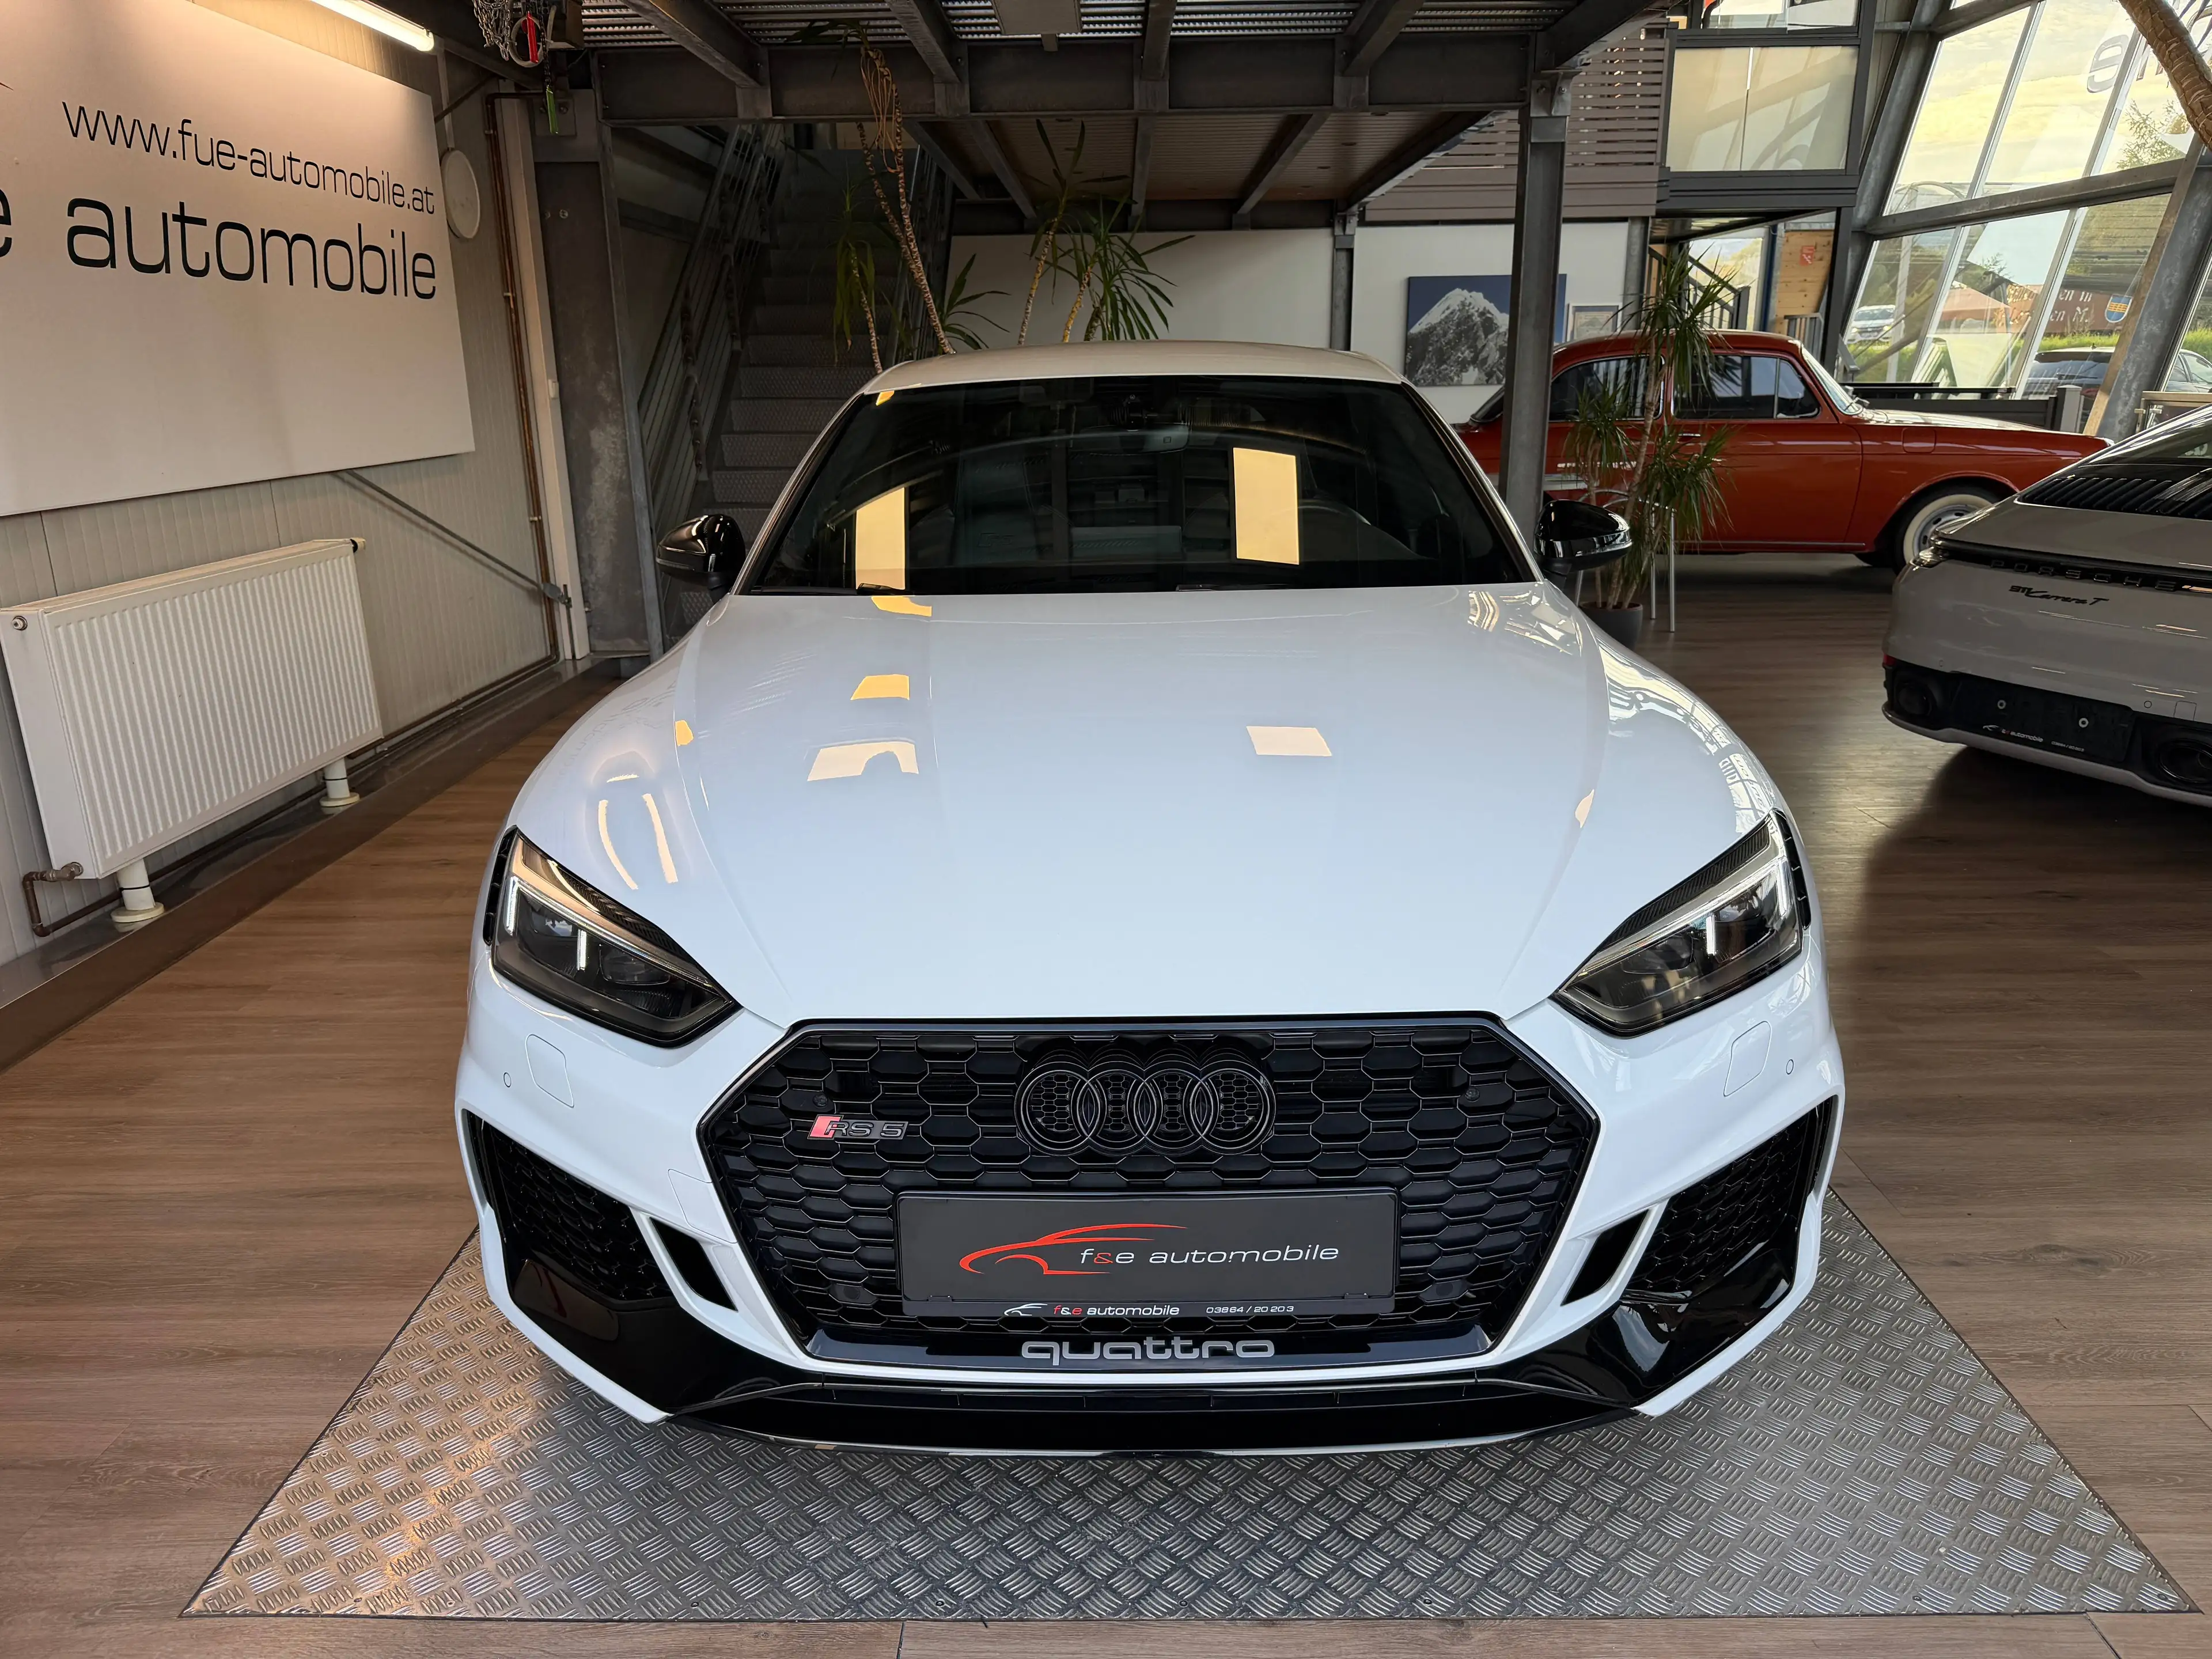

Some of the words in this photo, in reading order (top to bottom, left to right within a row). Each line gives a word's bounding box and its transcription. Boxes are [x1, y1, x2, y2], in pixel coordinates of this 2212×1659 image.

[62, 101, 435, 215] www.fue-automobile.at
[66, 198, 437, 301] automobile
[1990, 559, 2177, 592] PORSCHE
[823, 1120, 874, 1137] RS
[880, 1122, 905, 1137] 5
[1080, 1248, 1134, 1264] f&e
[1149, 1244, 1339, 1263] automobile
[1054, 1305, 1083, 1315] f&e
[1087, 1304, 1180, 1315] automobile
[1022, 1336, 1275, 1366] quattro
